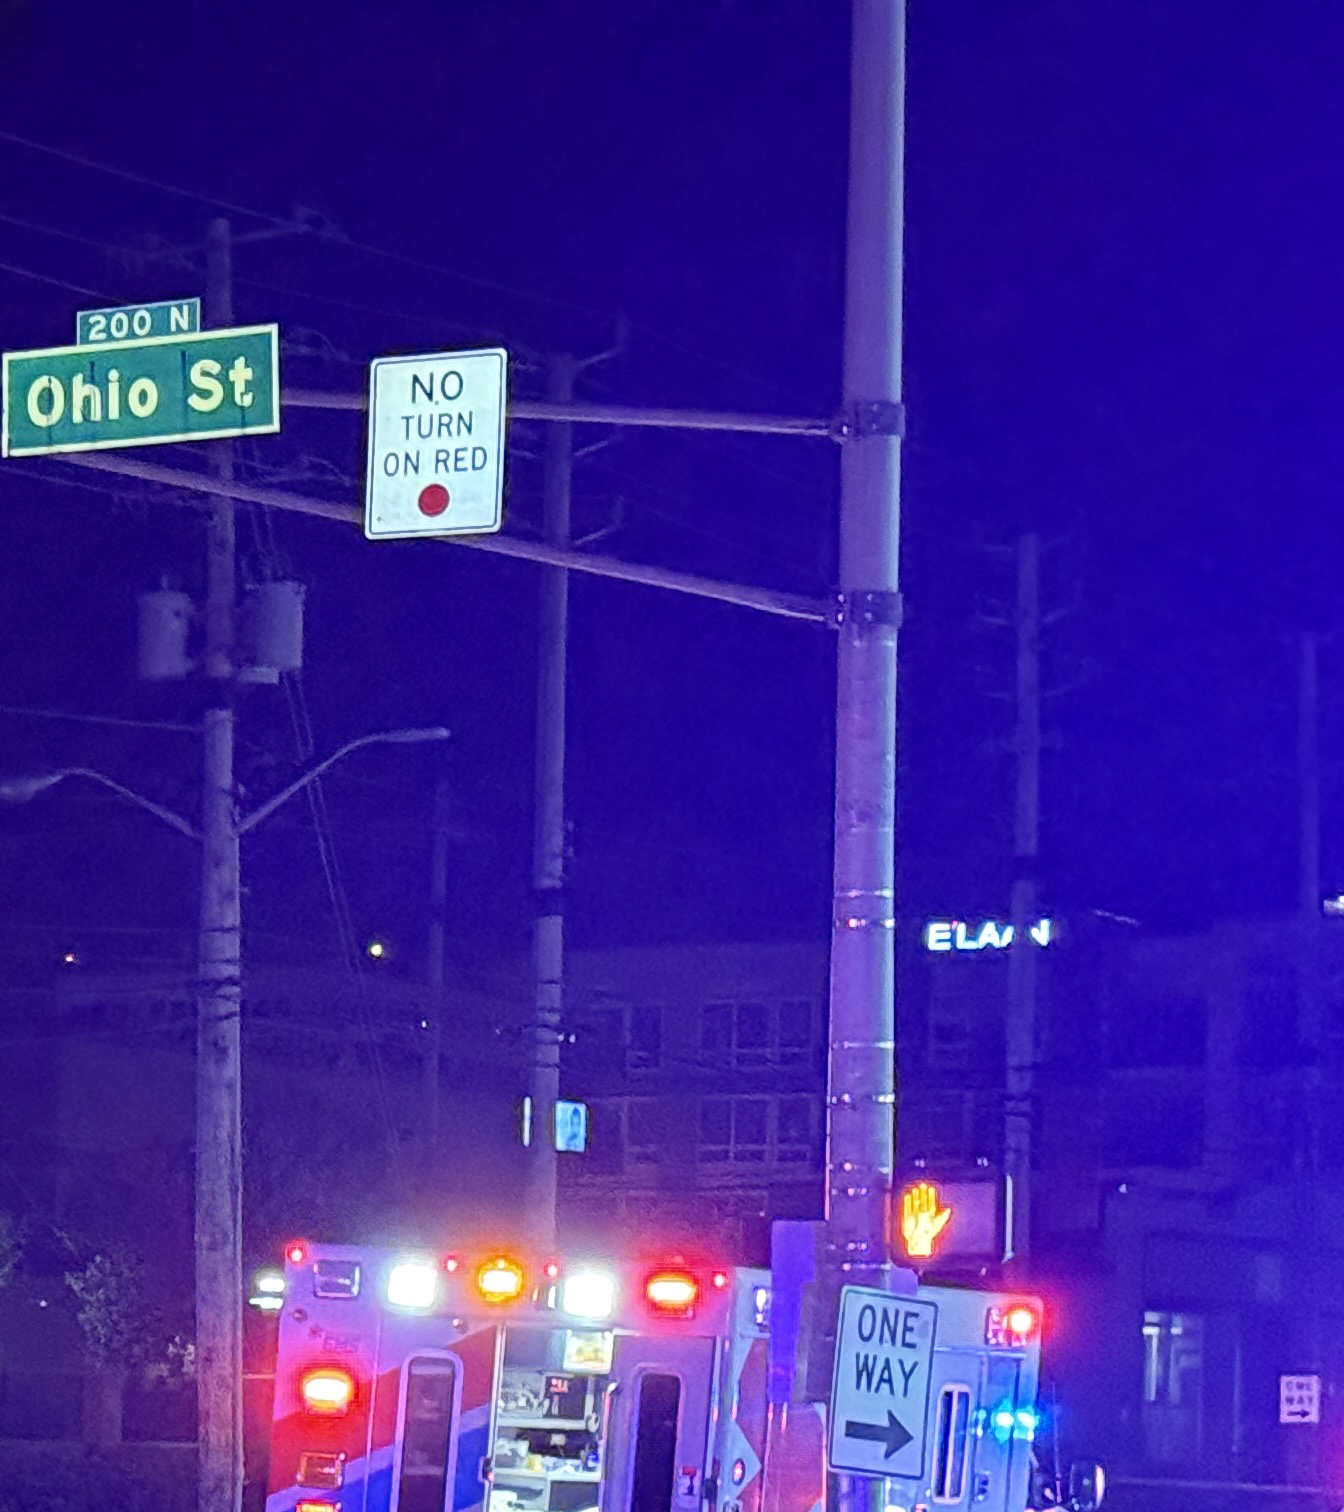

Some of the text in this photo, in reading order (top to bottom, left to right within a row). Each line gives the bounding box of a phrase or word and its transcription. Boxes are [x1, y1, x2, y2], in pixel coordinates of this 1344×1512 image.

[88, 304, 190, 341] 200 N
[26, 355, 254, 428] Ohio St
[411, 370, 464, 404] NO
[401, 410, 474, 440] TURN
[383, 446, 488, 478] ON RED
[857, 1303, 920, 1350] ONE
[855, 1352, 920, 1399] WAY
